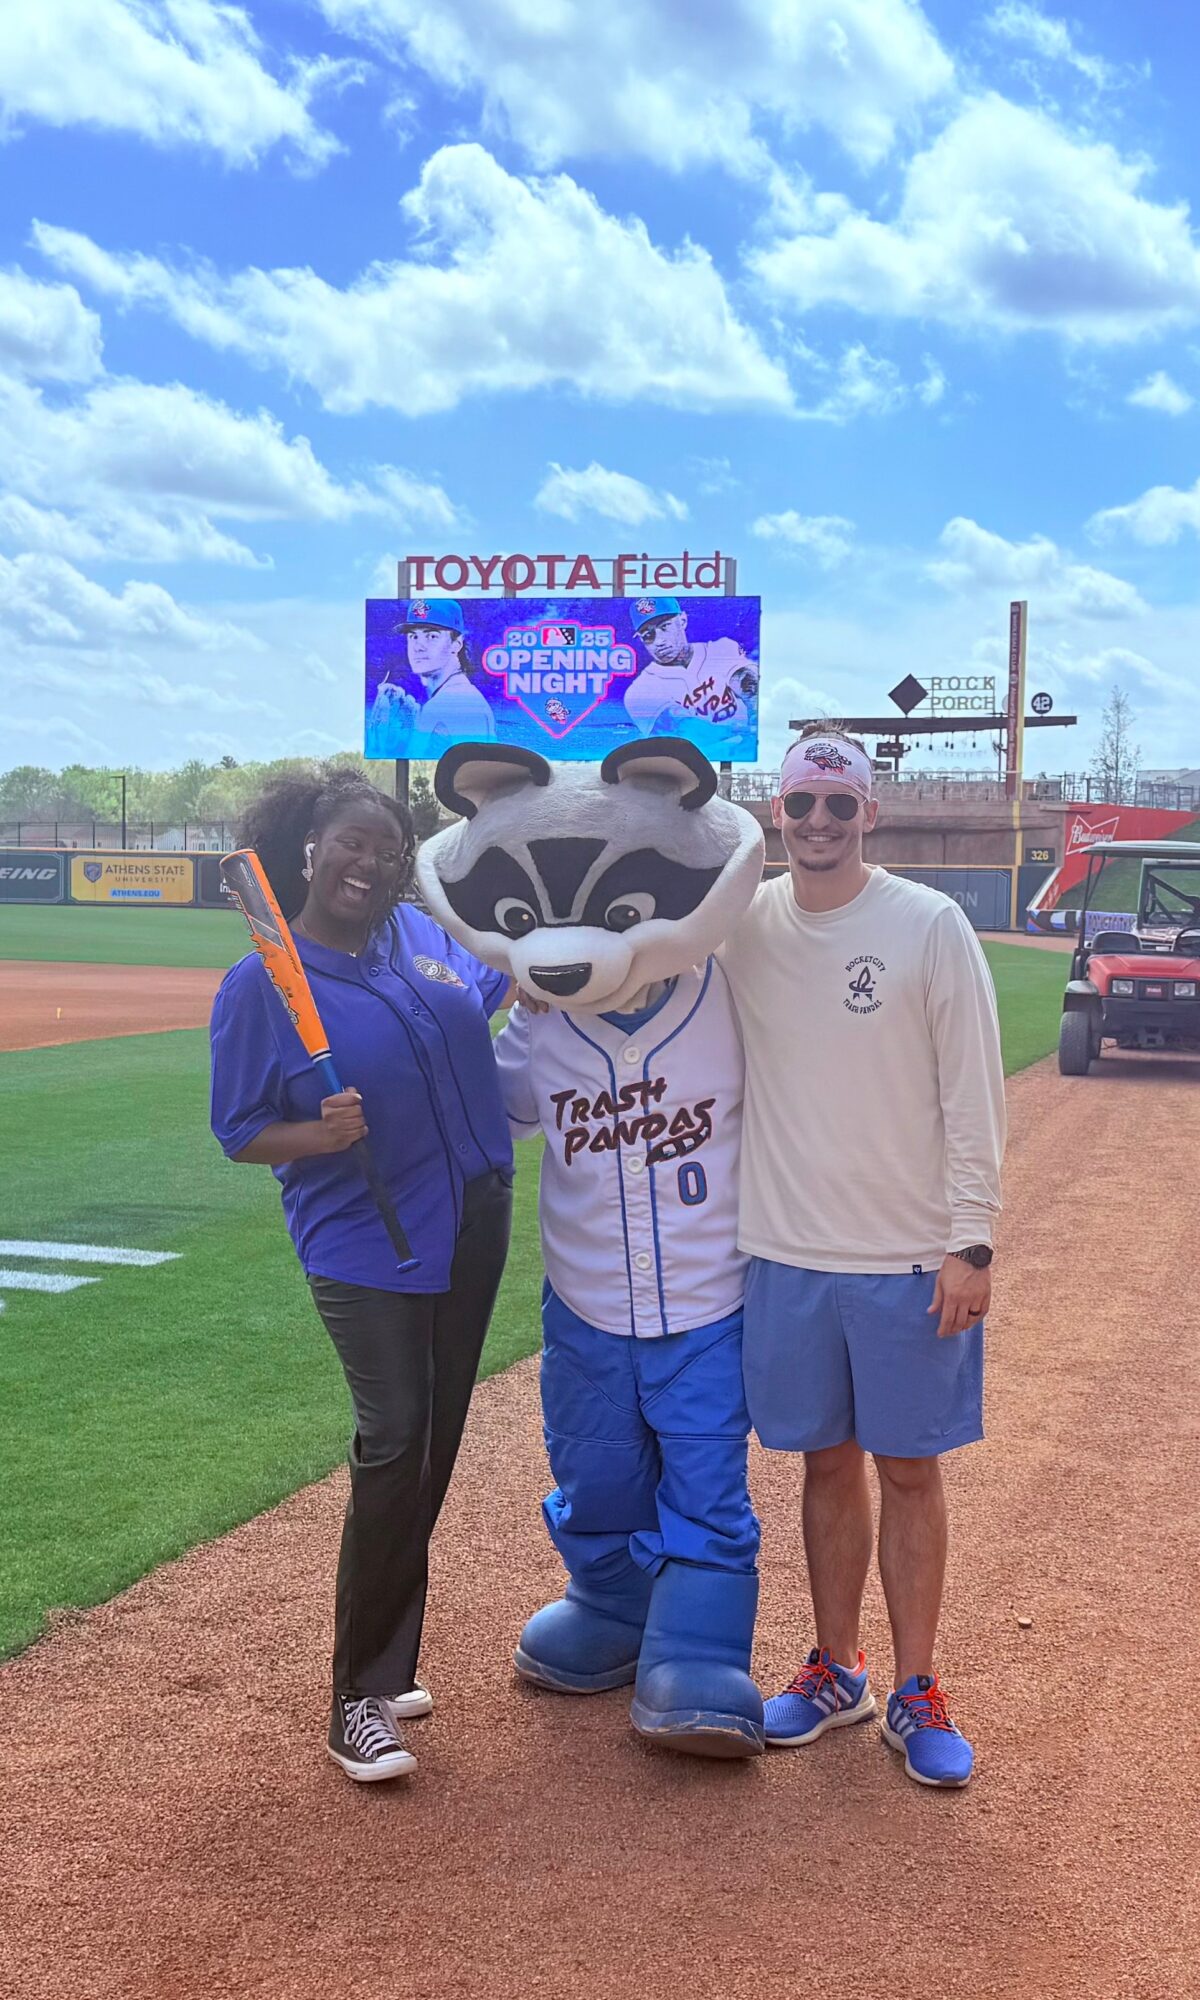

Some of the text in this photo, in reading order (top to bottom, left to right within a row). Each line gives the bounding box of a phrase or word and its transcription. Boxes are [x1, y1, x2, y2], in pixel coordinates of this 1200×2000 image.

[406, 550, 721, 591] TOYOTA Field
[508, 631, 609, 647] 20 25
[486, 649, 631, 671] OPENING
[509, 672, 609, 694] NIGHT
[932, 676, 994, 691] ROCK
[932, 696, 995, 710] PORCH
[1033, 697, 1050, 711] 42
[1031, 850, 1049, 861] 326
[105, 864, 185, 876] ATHENS STATE
[115, 876, 176, 884] UNIVERSITY
[550, 1077, 667, 1131] TRASH
[564, 1098, 716, 1167] PANDAS
